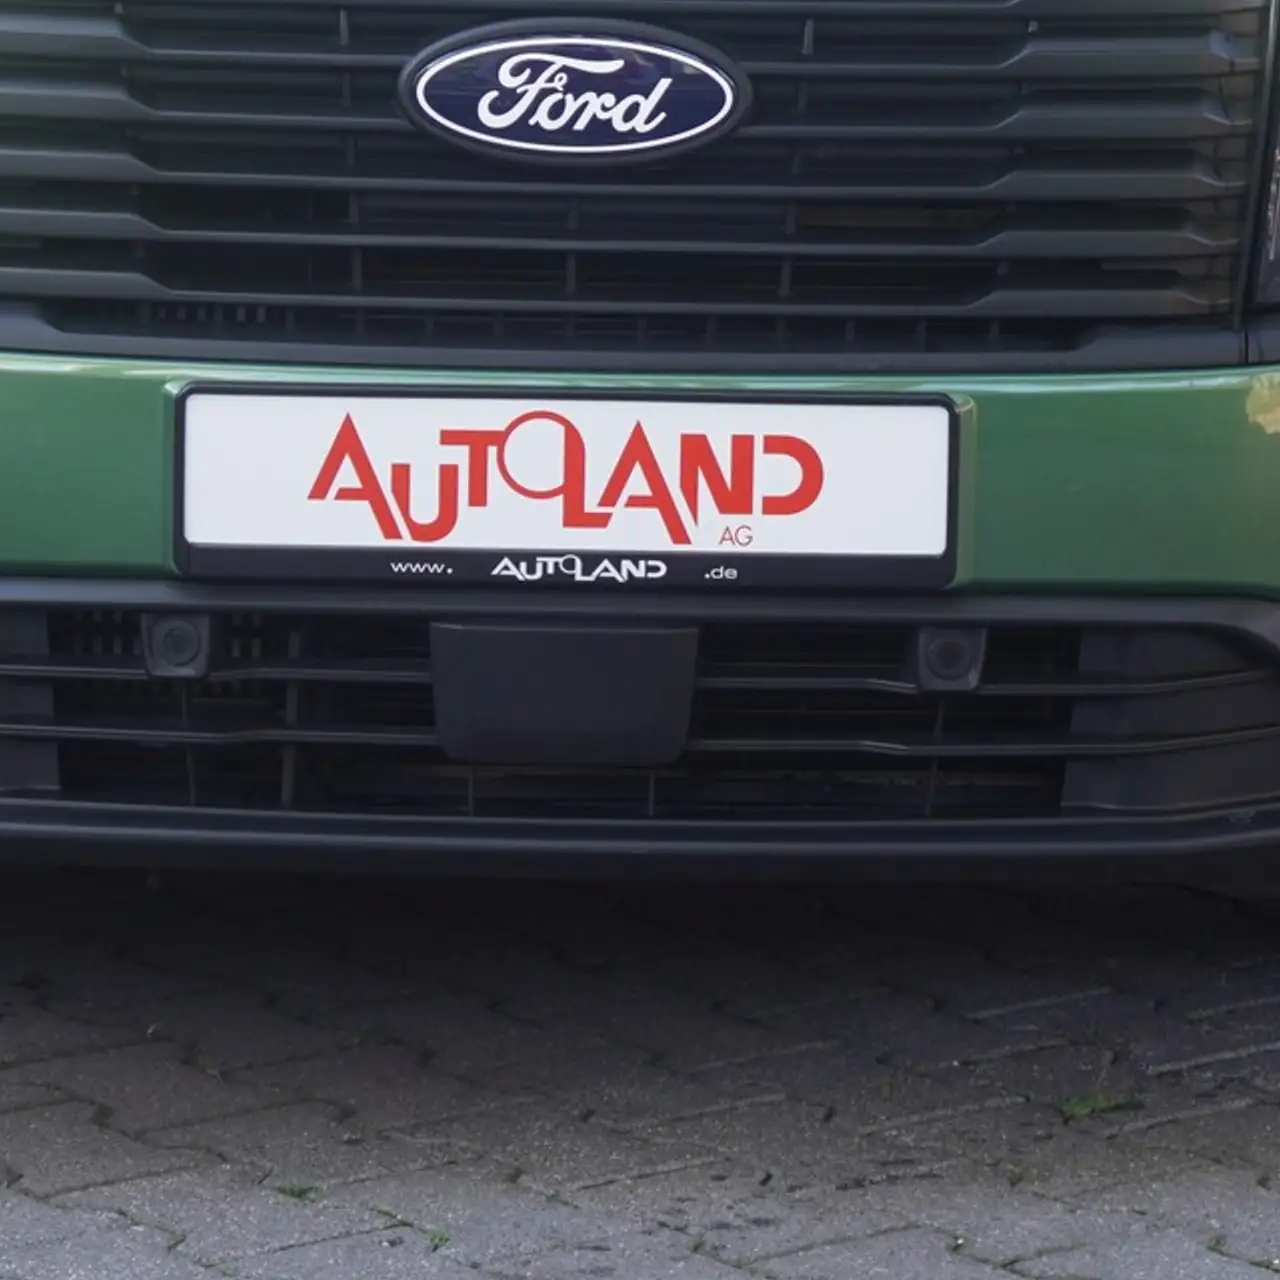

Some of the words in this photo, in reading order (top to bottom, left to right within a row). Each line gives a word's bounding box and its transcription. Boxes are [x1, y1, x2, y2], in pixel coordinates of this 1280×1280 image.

[477, 52, 673, 133] Ford
[307, 410, 824, 545] AUTOLAND
[718, 525, 753, 547] AG
[390, 561, 453, 575] www.
[704, 561, 738, 580] .de
